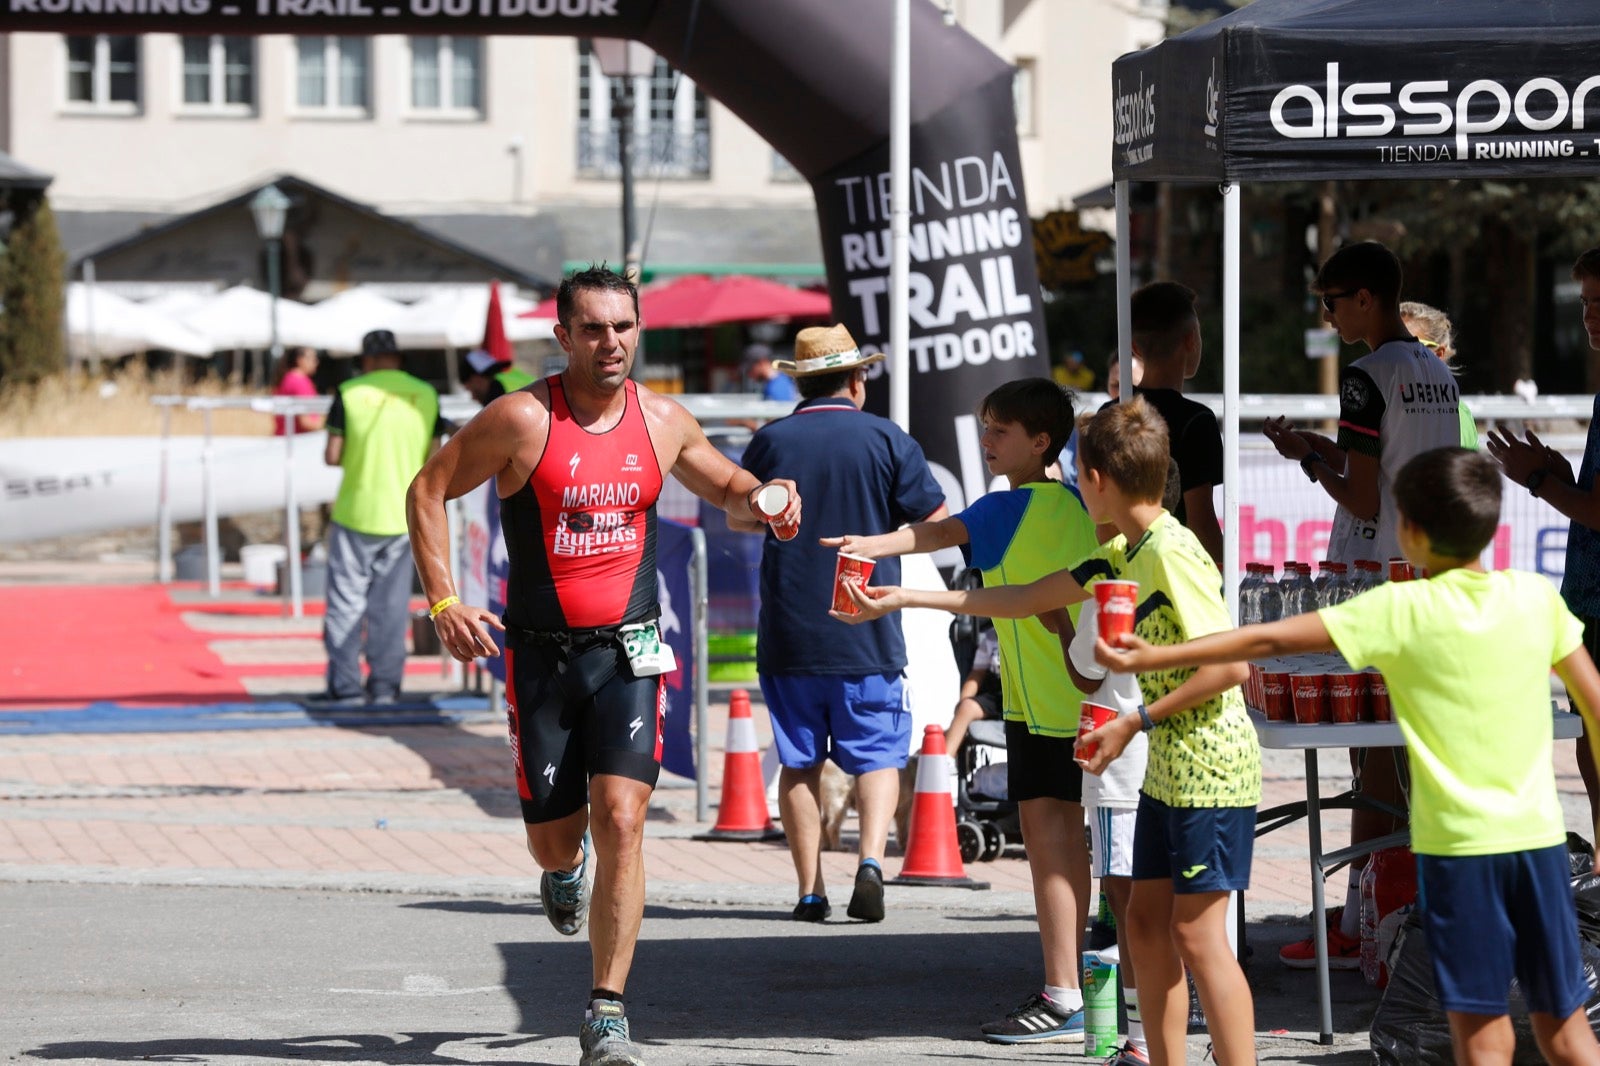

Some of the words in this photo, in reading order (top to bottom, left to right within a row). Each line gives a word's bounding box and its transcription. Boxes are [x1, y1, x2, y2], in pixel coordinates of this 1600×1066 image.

[1376, 144, 1451, 163] TIENDA
[1475, 139, 1575, 160] RUNNING
[842, 207, 1022, 273] RUNNING
[849, 255, 1032, 337] TRAIL
[562, 482, 640, 508] MARIANO
